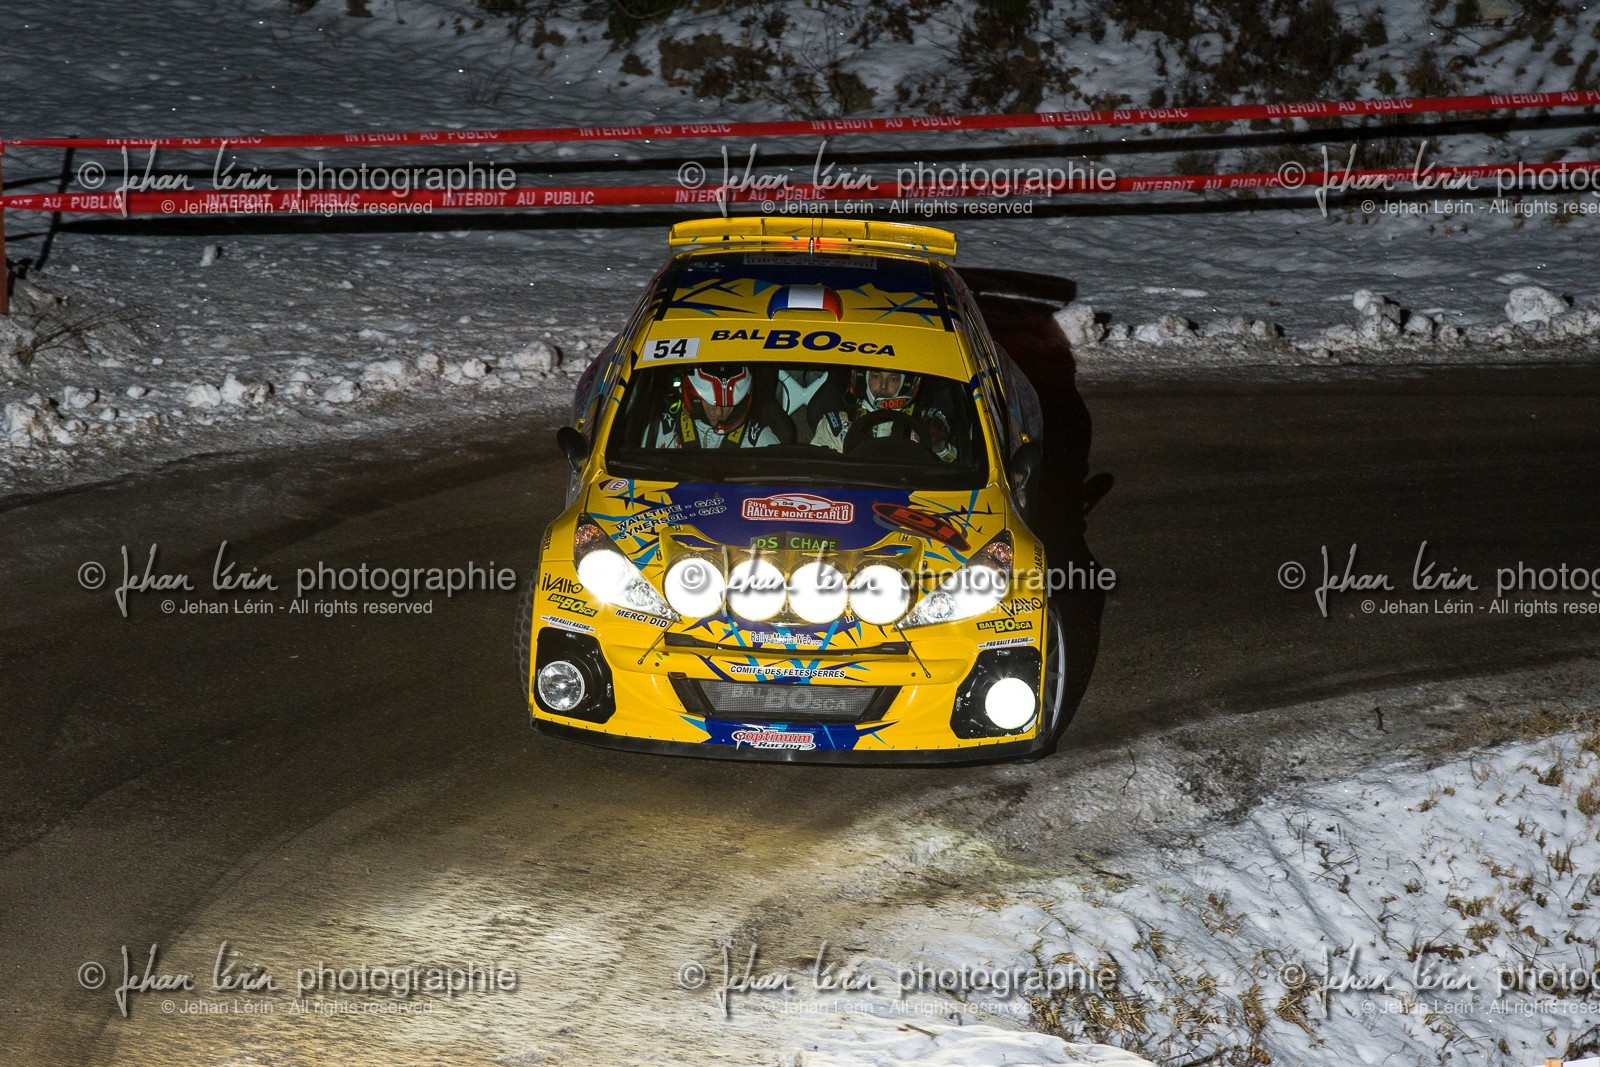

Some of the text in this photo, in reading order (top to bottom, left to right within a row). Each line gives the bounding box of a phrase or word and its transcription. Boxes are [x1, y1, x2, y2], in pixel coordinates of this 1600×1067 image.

[1490, 92, 1551, 105] INTERDIT
[1561, 91, 1579, 101] AU
[1266, 98, 1414, 114] INTERDIT AU PUBLIC
[1041, 107, 1188, 123] INTERDIT AU PUBLIC
[812, 115, 962, 130] INTERDIT AU PUBLIC
[580, 123, 732, 137] INTERDIT AU PUBLIC
[1132, 177, 1278, 191] INTERDIT AU PUBLIC
[442, 191, 594, 206] INTERDIT AU PUBLIC
[675, 188, 826, 203] INTERDIT AU PUBLIC
[43, 197, 61, 209] AU
[71, 198, 121, 209] PUBLIC
[653, 338, 688, 359] 54
[748, 500, 767, 509] 2016
[615, 497, 725, 531] WALLTITE GAP
[747, 507, 779, 517] RALLYE
[617, 505, 727, 540] SYNERSOL GAP
[757, 537, 836, 550] DS CHAPE
[559, 618, 573, 626] RALLY
[572, 622, 590, 630] RACING
[615, 609, 668, 628] MERCI DID
[750, 631, 772, 644] Rallye
[772, 633, 794, 644] Media
[757, 741, 801, 750] Racing
